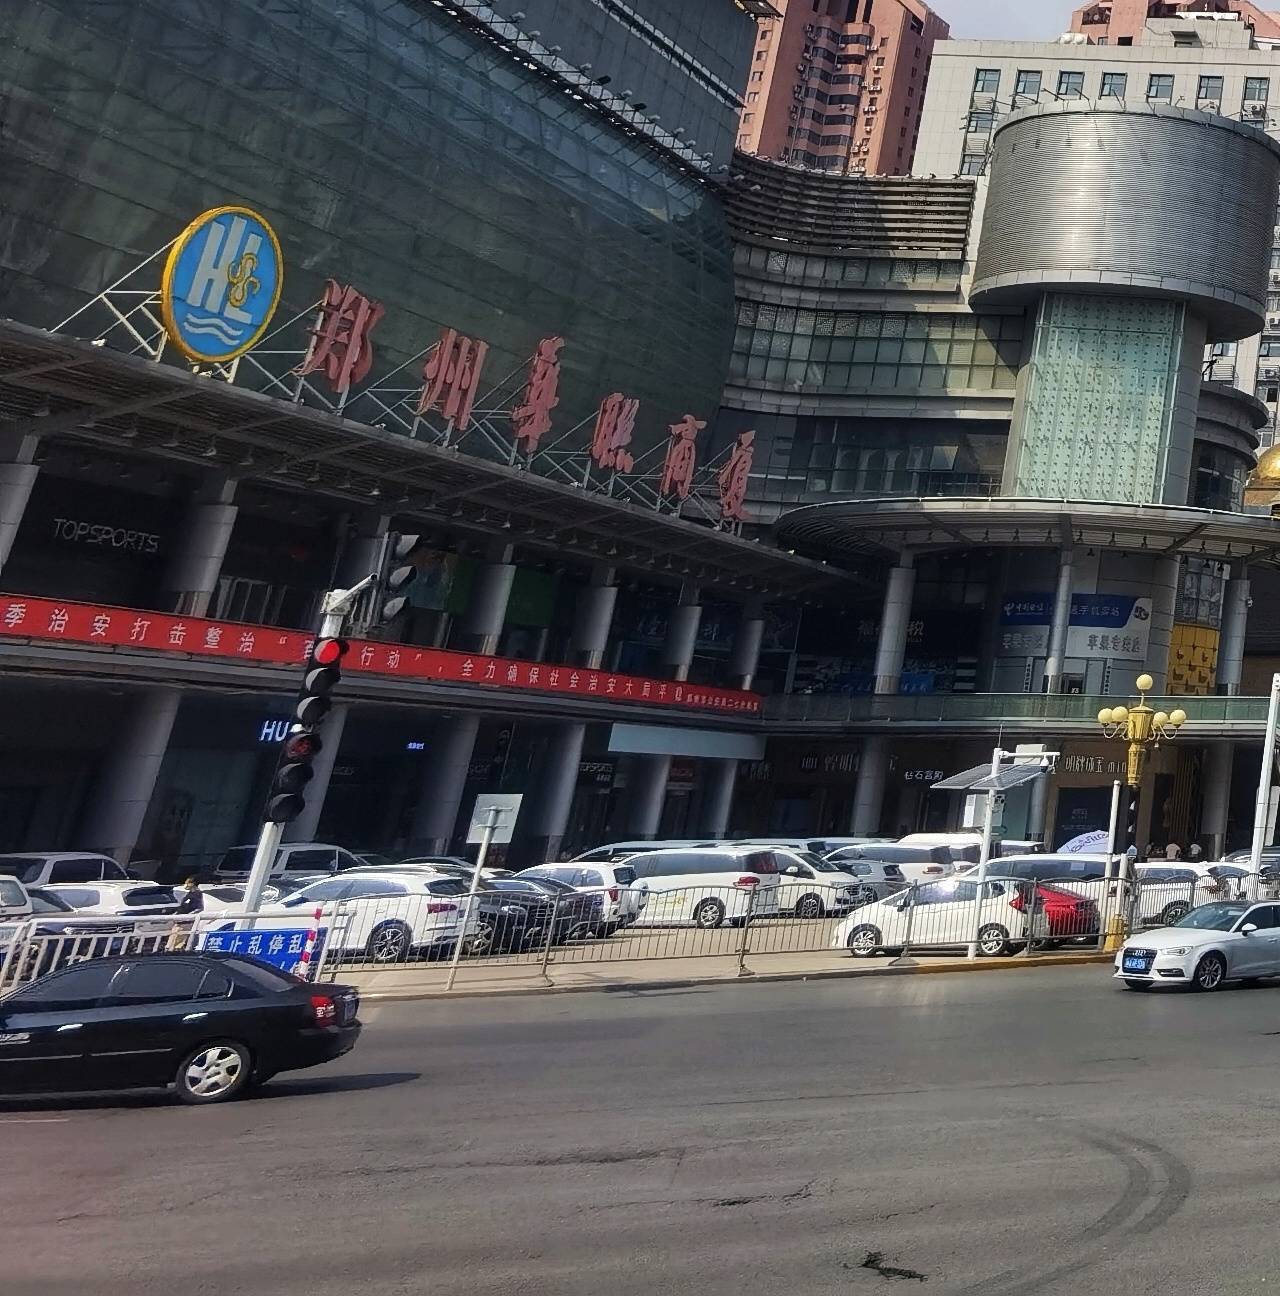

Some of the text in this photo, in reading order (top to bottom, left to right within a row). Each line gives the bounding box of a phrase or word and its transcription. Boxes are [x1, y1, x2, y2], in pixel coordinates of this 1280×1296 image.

[53, 517, 160, 553] TOPSPORTS
[207, 932, 322, 956] 禁止乱停乱
